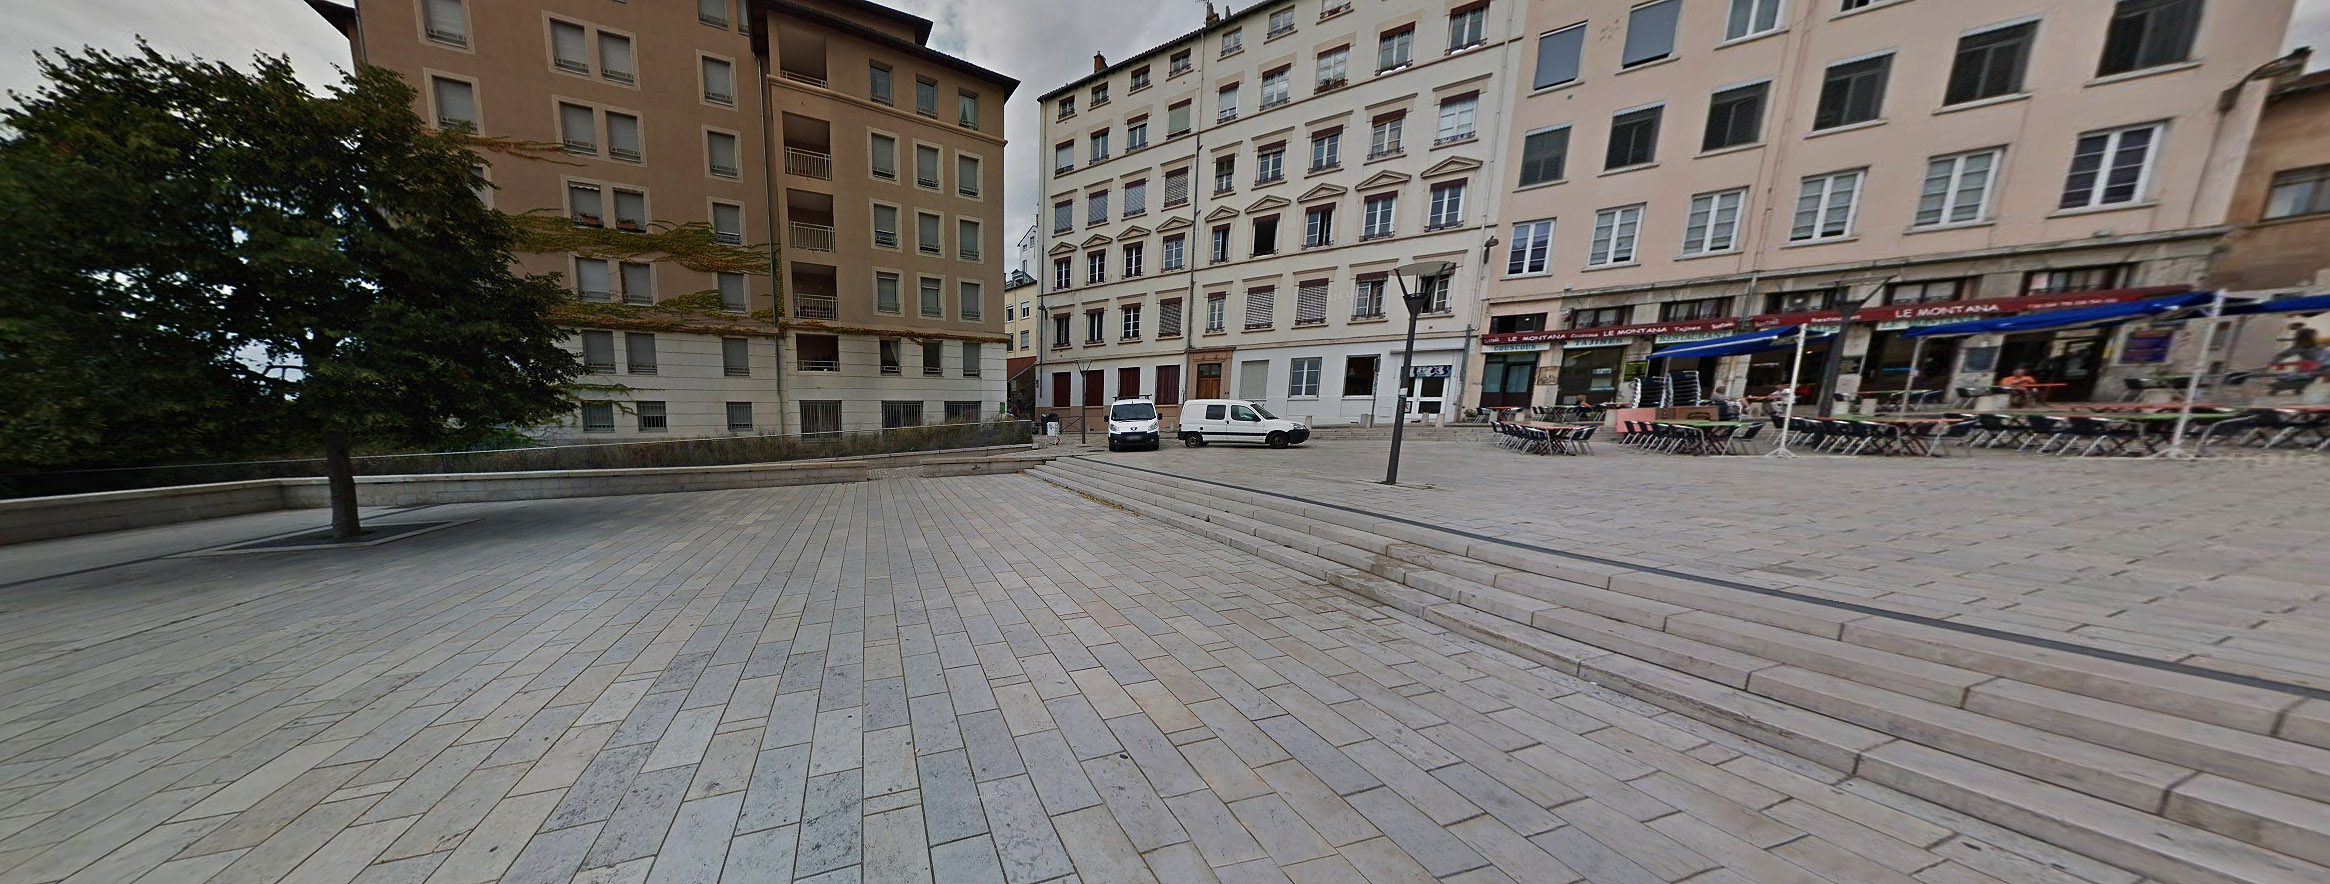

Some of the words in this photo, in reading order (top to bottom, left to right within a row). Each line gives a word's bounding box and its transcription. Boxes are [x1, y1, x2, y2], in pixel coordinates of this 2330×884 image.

[1894, 308, 1912, 318] LE
[1916, 303, 2000, 316] MONTANA
[1522, 333, 1566, 341] MONTANA
[1616, 326, 1668, 335] MONTANA
[1493, 343, 1537, 351] COUSCOUS
[1575, 337, 1624, 346] TAJINES
